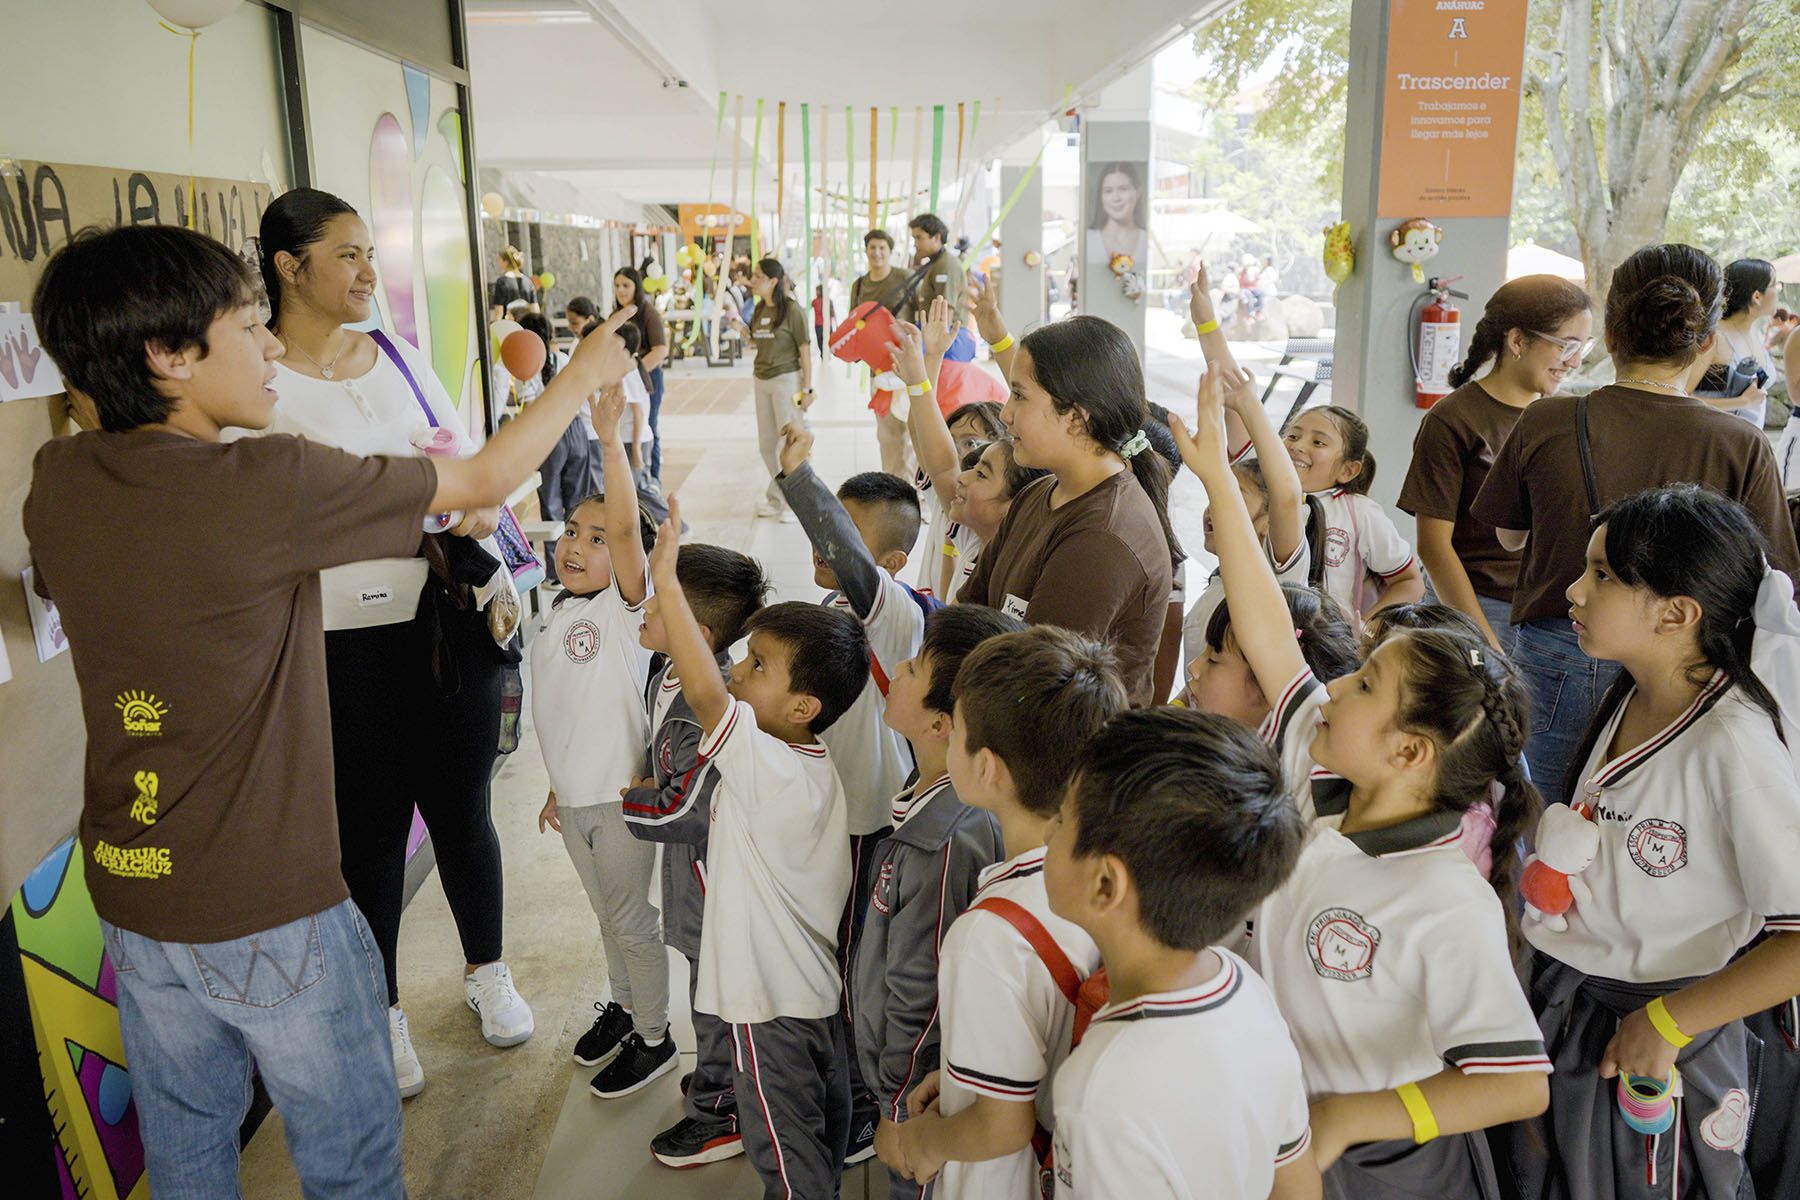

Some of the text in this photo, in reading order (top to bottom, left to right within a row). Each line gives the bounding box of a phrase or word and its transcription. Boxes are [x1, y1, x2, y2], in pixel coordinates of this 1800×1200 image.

[1448, 18, 1467, 38] A
[1397, 73, 1510, 90] Trascender
[1418, 101, 1478, 112] Trabajamos
[1410, 116, 1491, 126] innovamos para
[1410, 129, 1440, 140] llegar
[1466, 129, 1488, 140] lejos
[123, 717, 162, 731] Soñar
[93, 851, 173, 875] VERACRUZ
